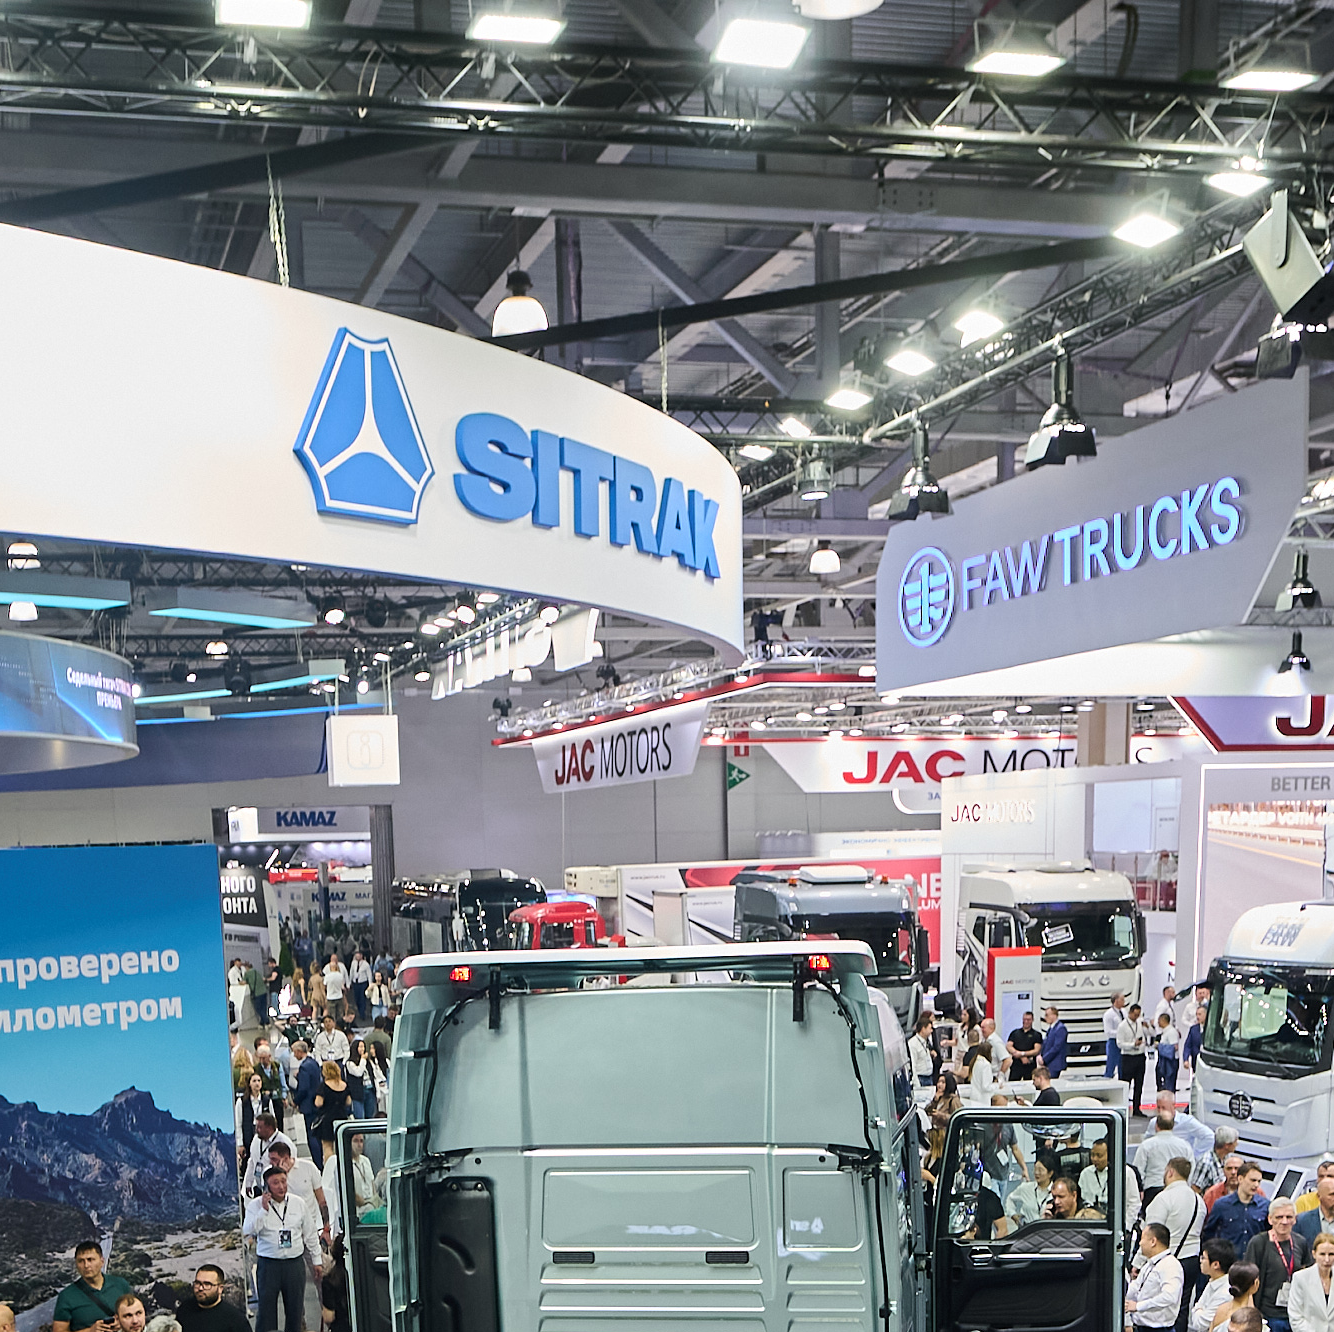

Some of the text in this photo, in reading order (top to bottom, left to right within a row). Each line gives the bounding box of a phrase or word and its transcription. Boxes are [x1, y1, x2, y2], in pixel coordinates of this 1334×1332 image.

[453, 411, 721, 580] SITRAK
[1054, 476, 1244, 587] TRUCKS
[555, 722, 672, 786] JAC MOTORS
[842, 749, 967, 784] JAC
[1270, 776, 1331, 793] BETTER
[276, 811, 337, 827] KAMAZ
[950, 803, 981, 822] JAC
[1066, 974, 1111, 988] JAC
